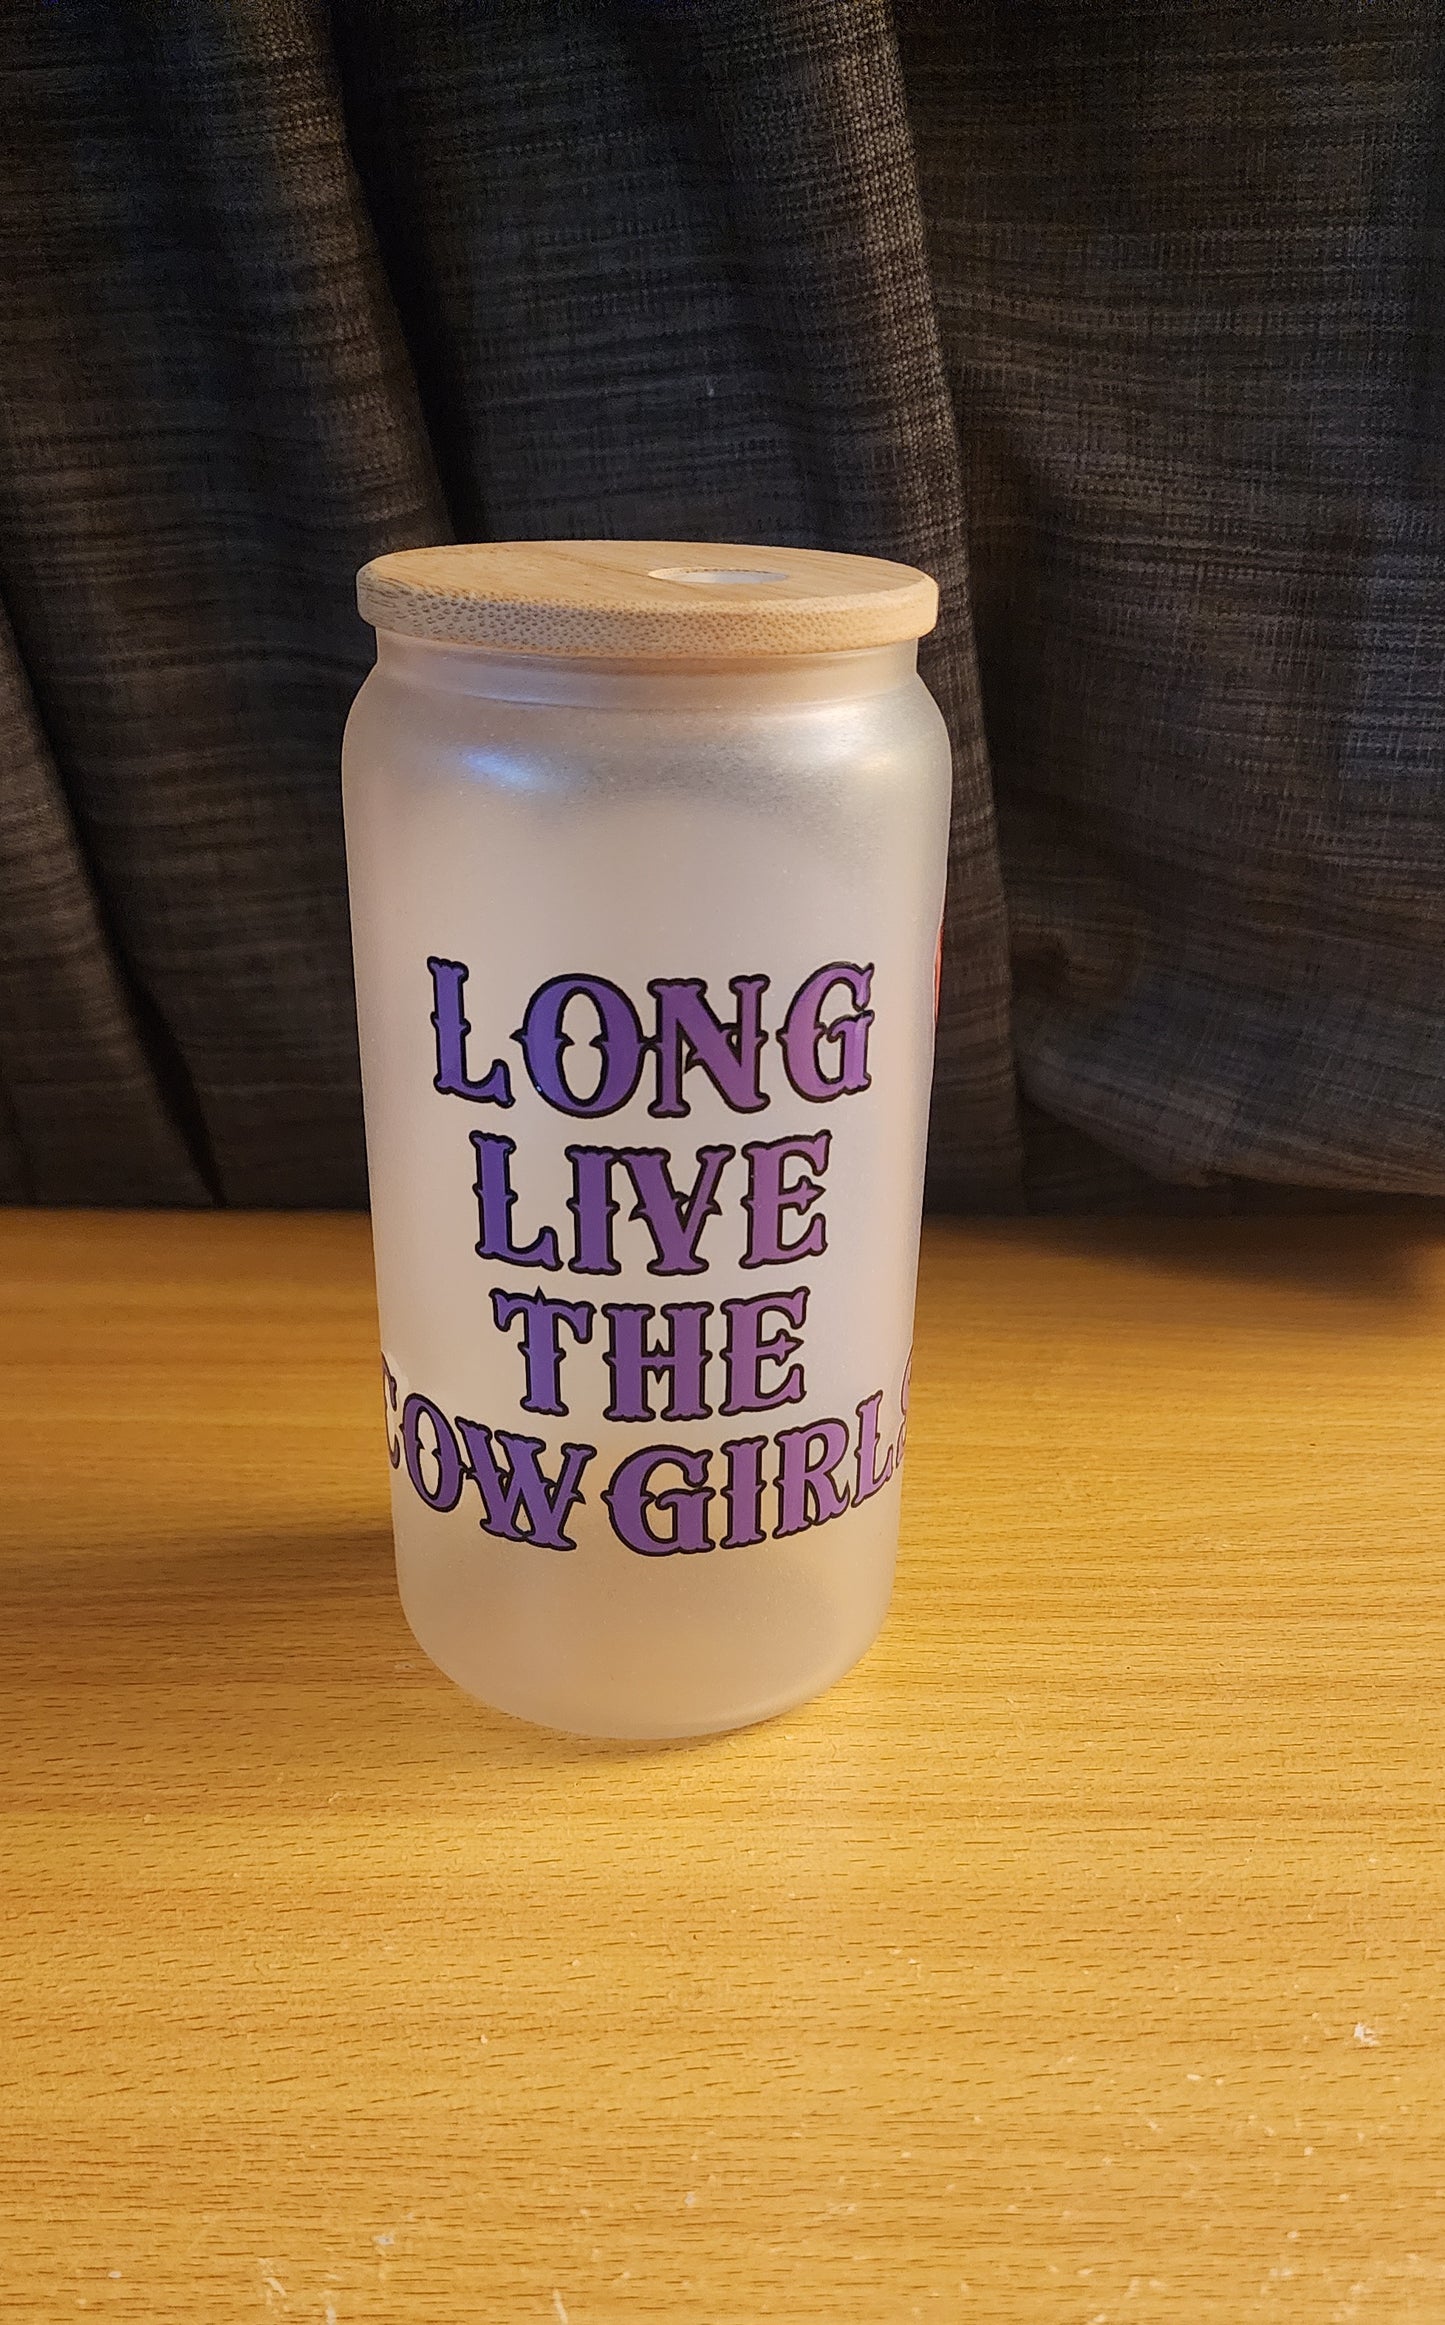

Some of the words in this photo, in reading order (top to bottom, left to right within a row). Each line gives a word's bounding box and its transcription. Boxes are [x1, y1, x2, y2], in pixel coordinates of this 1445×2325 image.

[426, 955, 875, 1118] LONG
[469, 1130, 833, 1277] LIVE
[489, 1286, 810, 1423] THE
